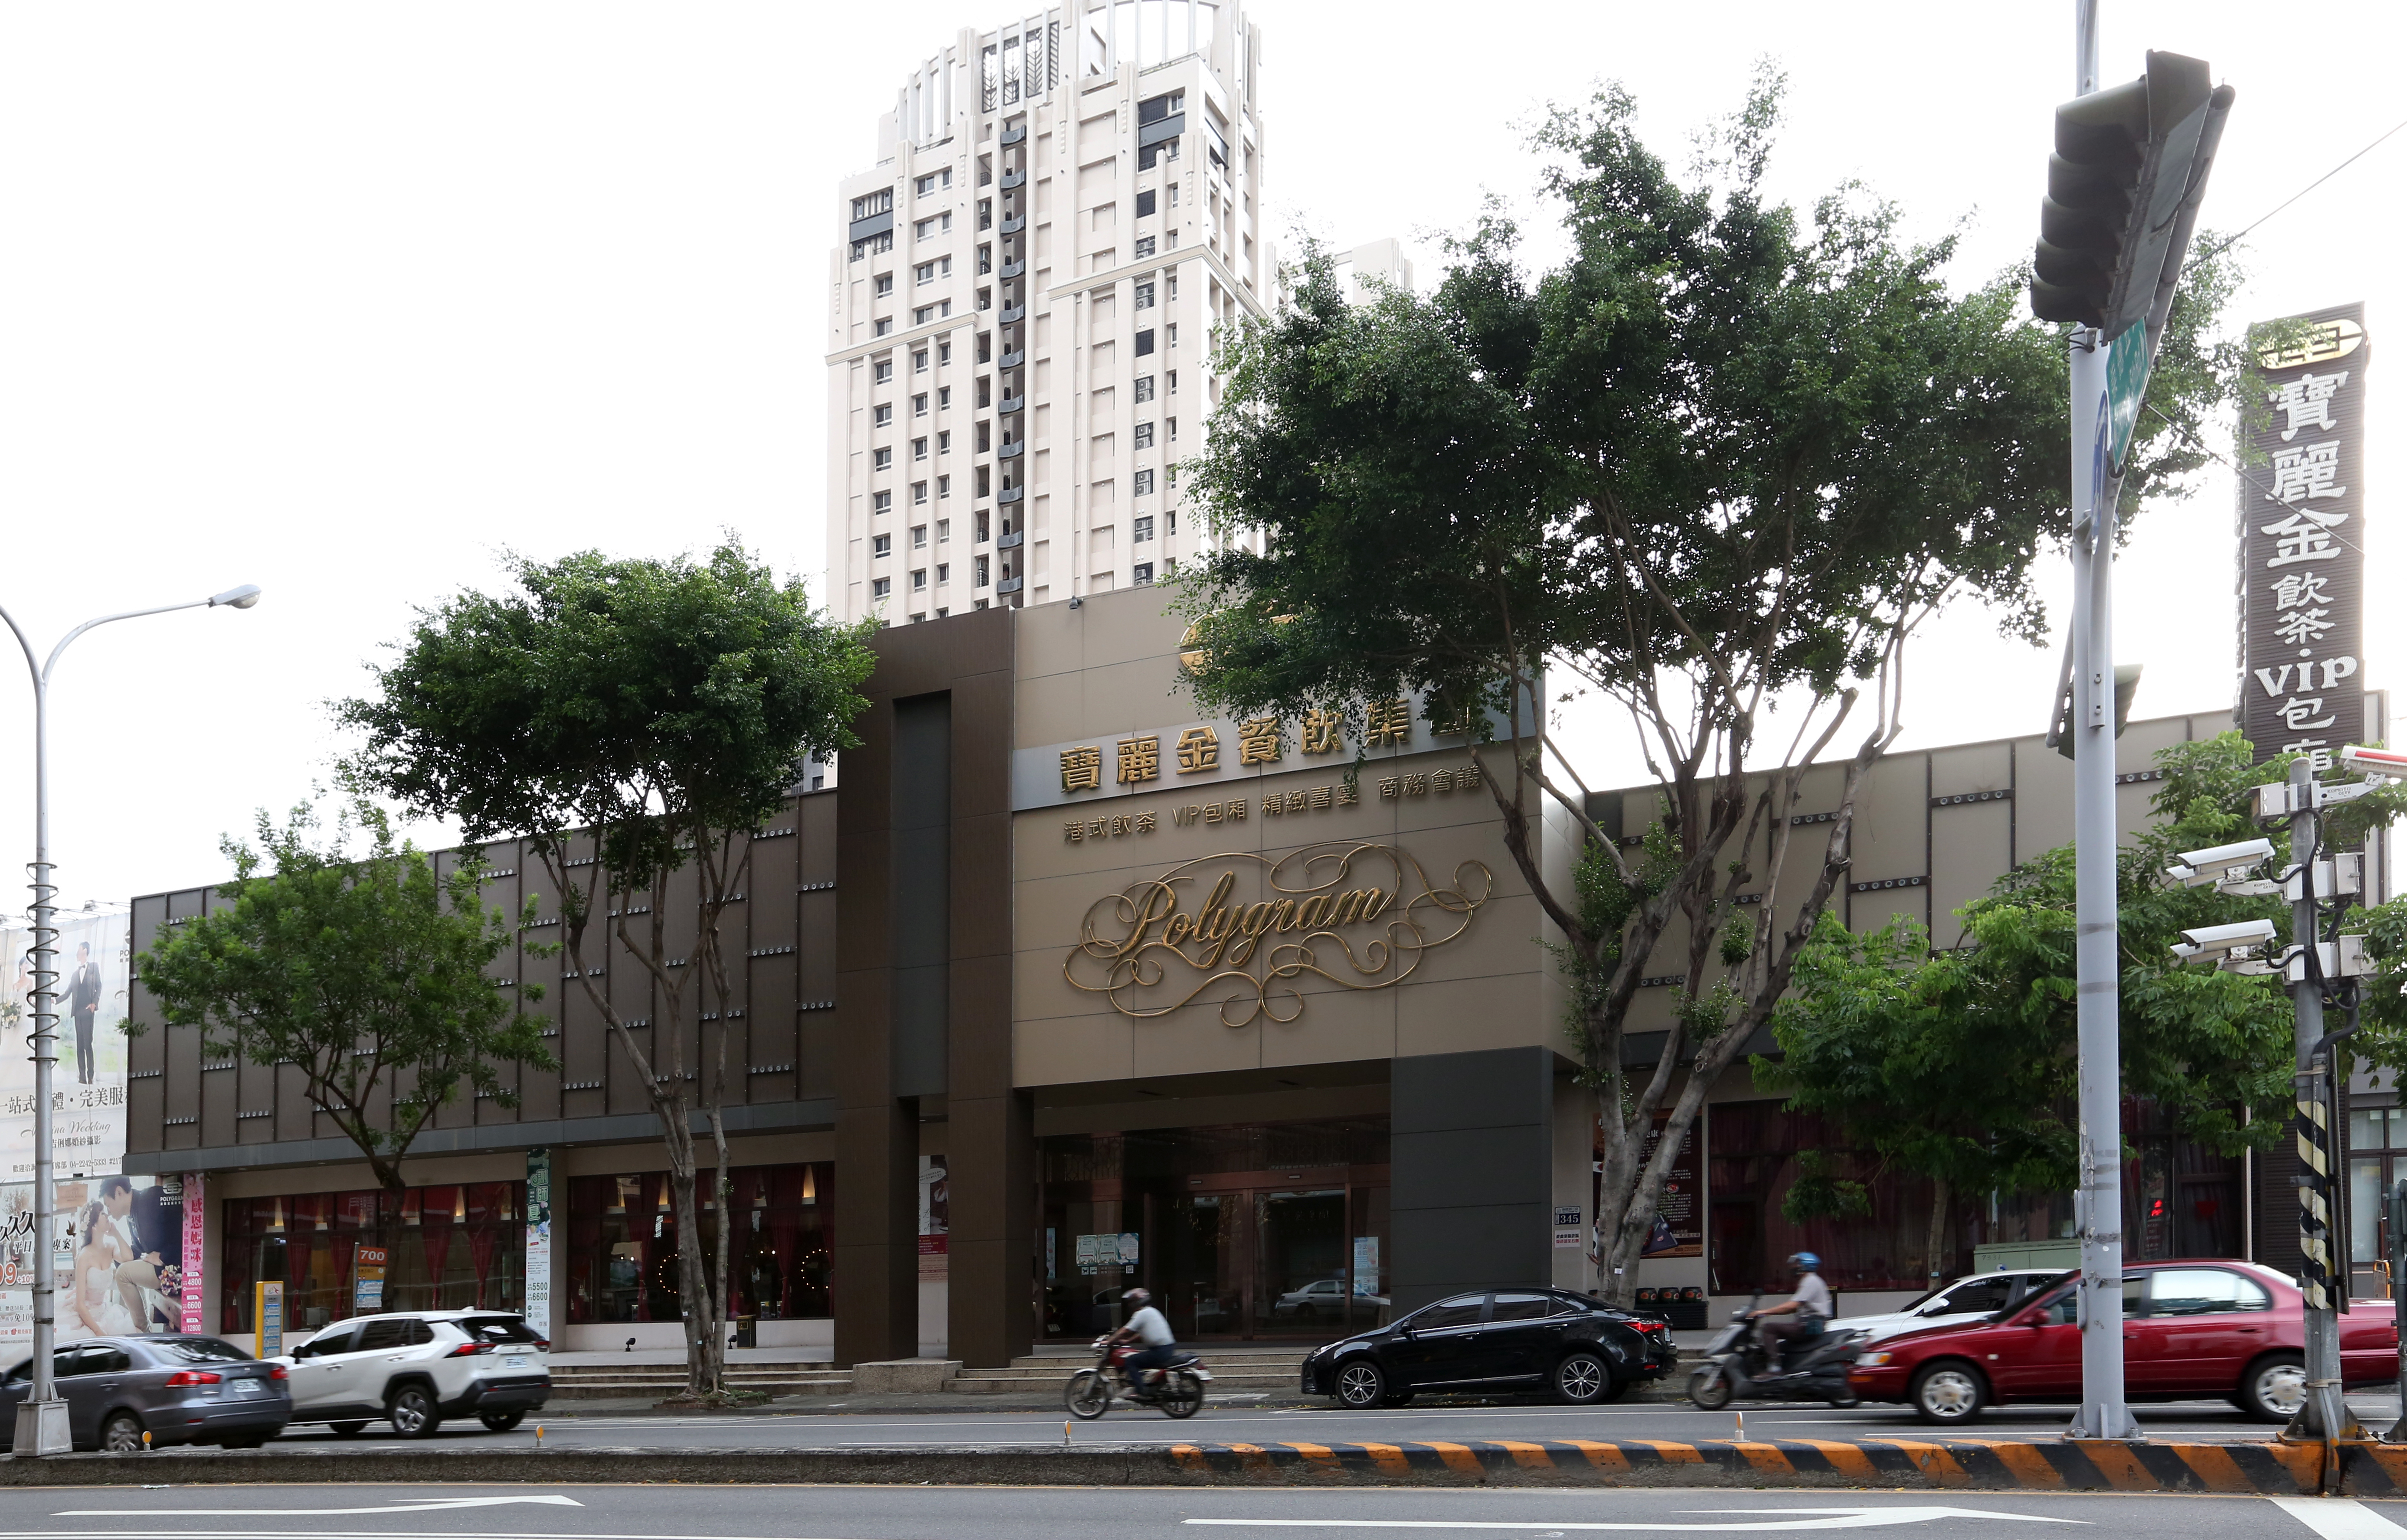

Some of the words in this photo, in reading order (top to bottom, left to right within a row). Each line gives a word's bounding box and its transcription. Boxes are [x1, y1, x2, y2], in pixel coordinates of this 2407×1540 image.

[2260, 371, 2349, 568] 寶麗金
[1060, 696, 1470, 793] 寶麗金餐飲集
[1064, 810, 1157, 843] 港式飲茶
[1172, 798, 1247, 827] VIP包廂
[1261, 783, 1357, 816] 精緻喜宴
[1378, 766, 1480, 801] 商務會議
[69, 1119, 111, 1135] Wedding
[70, 1158, 107, 1168] 04-2242-5333
[1560, 1214, 1579, 1223] 345
[191, 1198, 203, 1262] 感恩媽咪
[360, 1250, 385, 1261] 700
[533, 1282, 548, 1291] 5500
[533, 1292, 548, 1301] 6600
